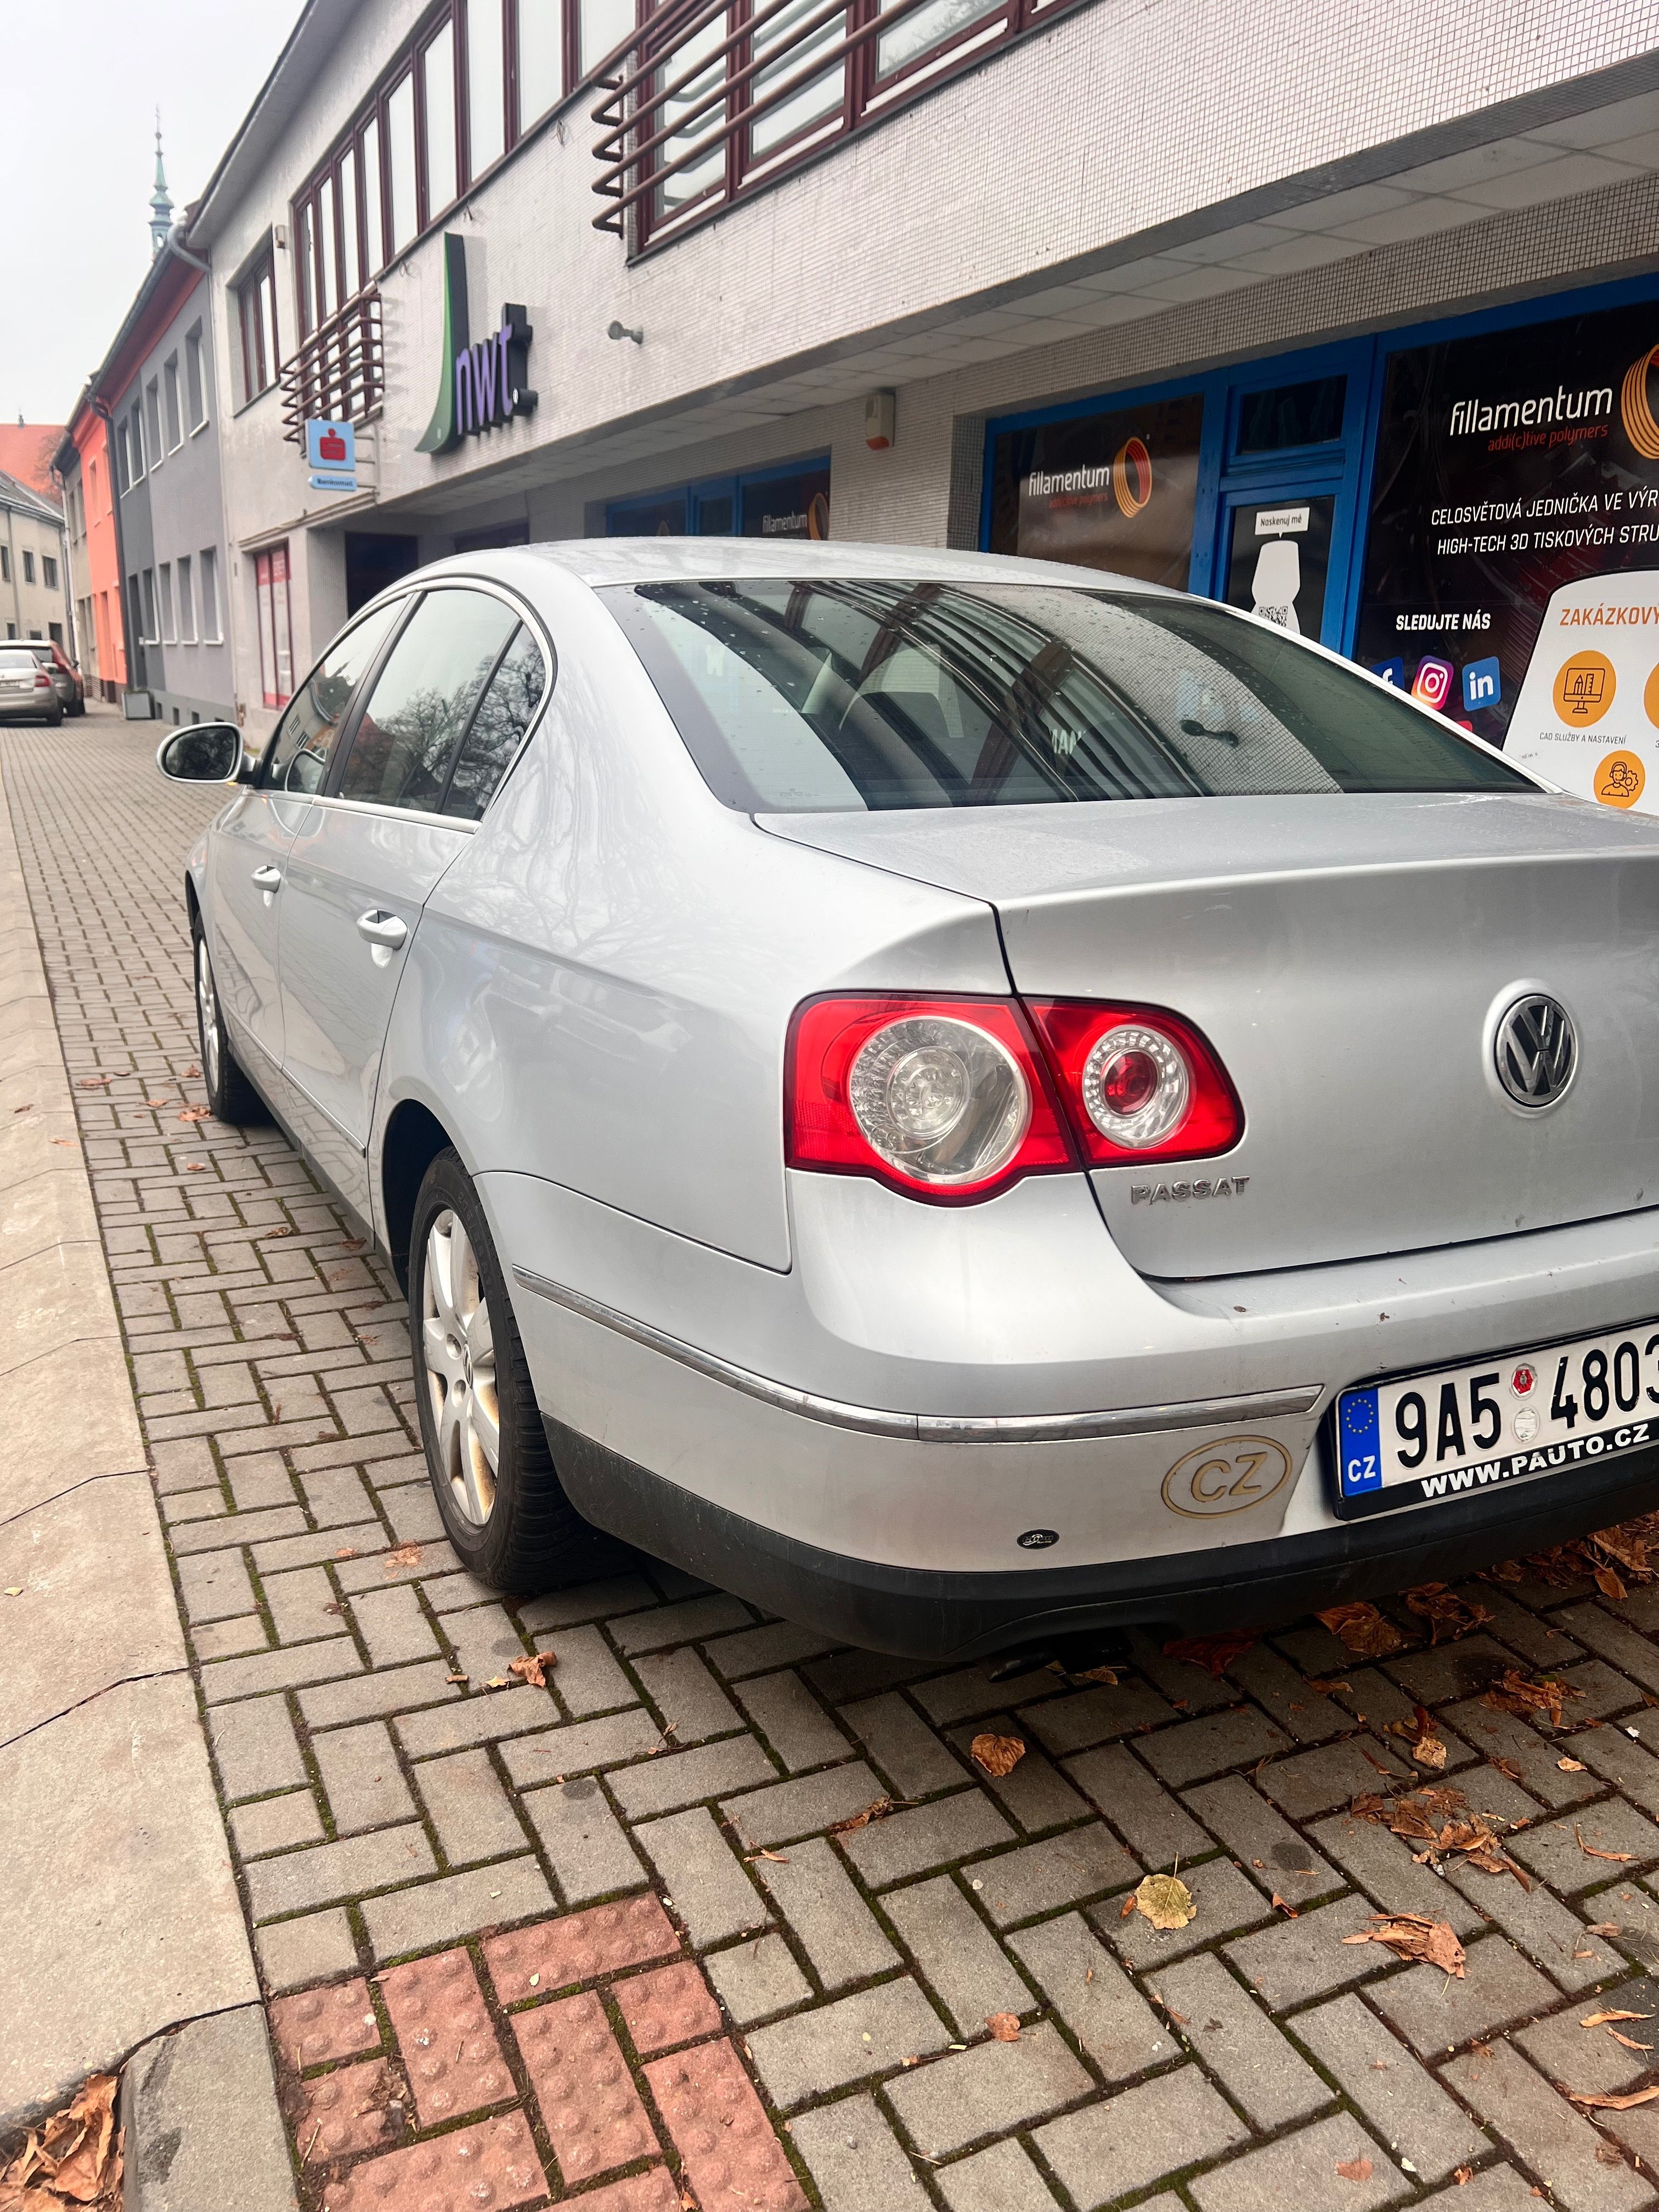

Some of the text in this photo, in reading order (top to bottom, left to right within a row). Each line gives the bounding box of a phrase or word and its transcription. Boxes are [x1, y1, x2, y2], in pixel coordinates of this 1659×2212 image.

[1449, 385, 1612, 436] fillamentum
[1487, 424, 1609, 452] addi(c)tive polymers
[1028, 464, 1110, 496] fillamentum
[1261, 515, 1290, 527] Naskenuj
[1431, 485, 1659, 526] CELOSVĚTOVÁ JEDNIČKA VE VÝR
[1437, 523, 1659, 555] HIGH-TECH 3D TISKOVÝCH STRU
[1396, 608, 1491, 631] SLEDUJTE NÁS
[1539, 732, 1553, 741] CAD
[1554, 732, 1580, 742] SLUŽBY
[1588, 735, 1627, 745] NASTAVENÍ
[1131, 1175, 1251, 1205] PASSAT
[1395, 1372, 1502, 1469] 9A5
[1347, 1455, 1376, 1483] CZ
[1421, 1423, 1650, 1498] WWW.PAUTO.CZ
[1190, 1451, 1268, 1503] CZ
